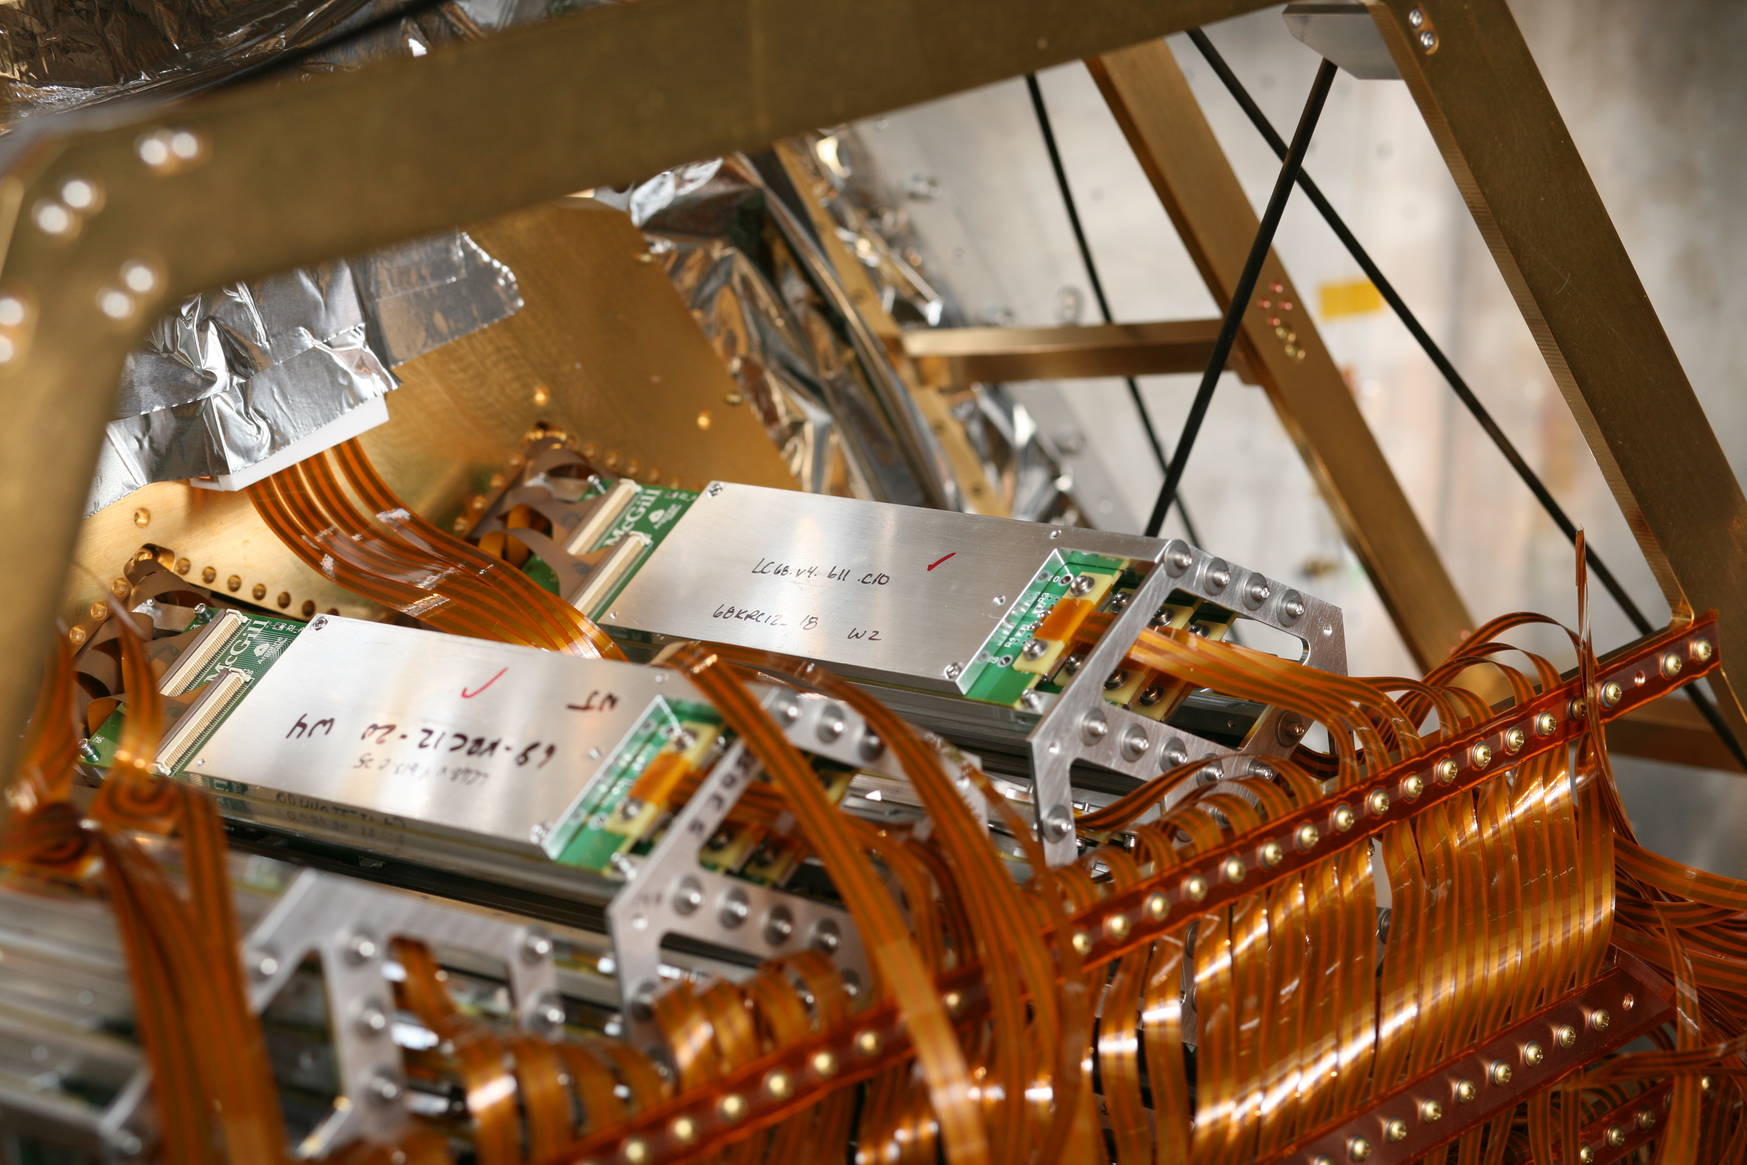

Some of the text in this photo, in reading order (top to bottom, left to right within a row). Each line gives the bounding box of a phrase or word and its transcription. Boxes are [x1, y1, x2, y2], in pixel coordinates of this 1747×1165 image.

[603, 488, 663, 547] McGill
[203, 619, 269, 683] McGill
[847, 627, 883, 641] W2
